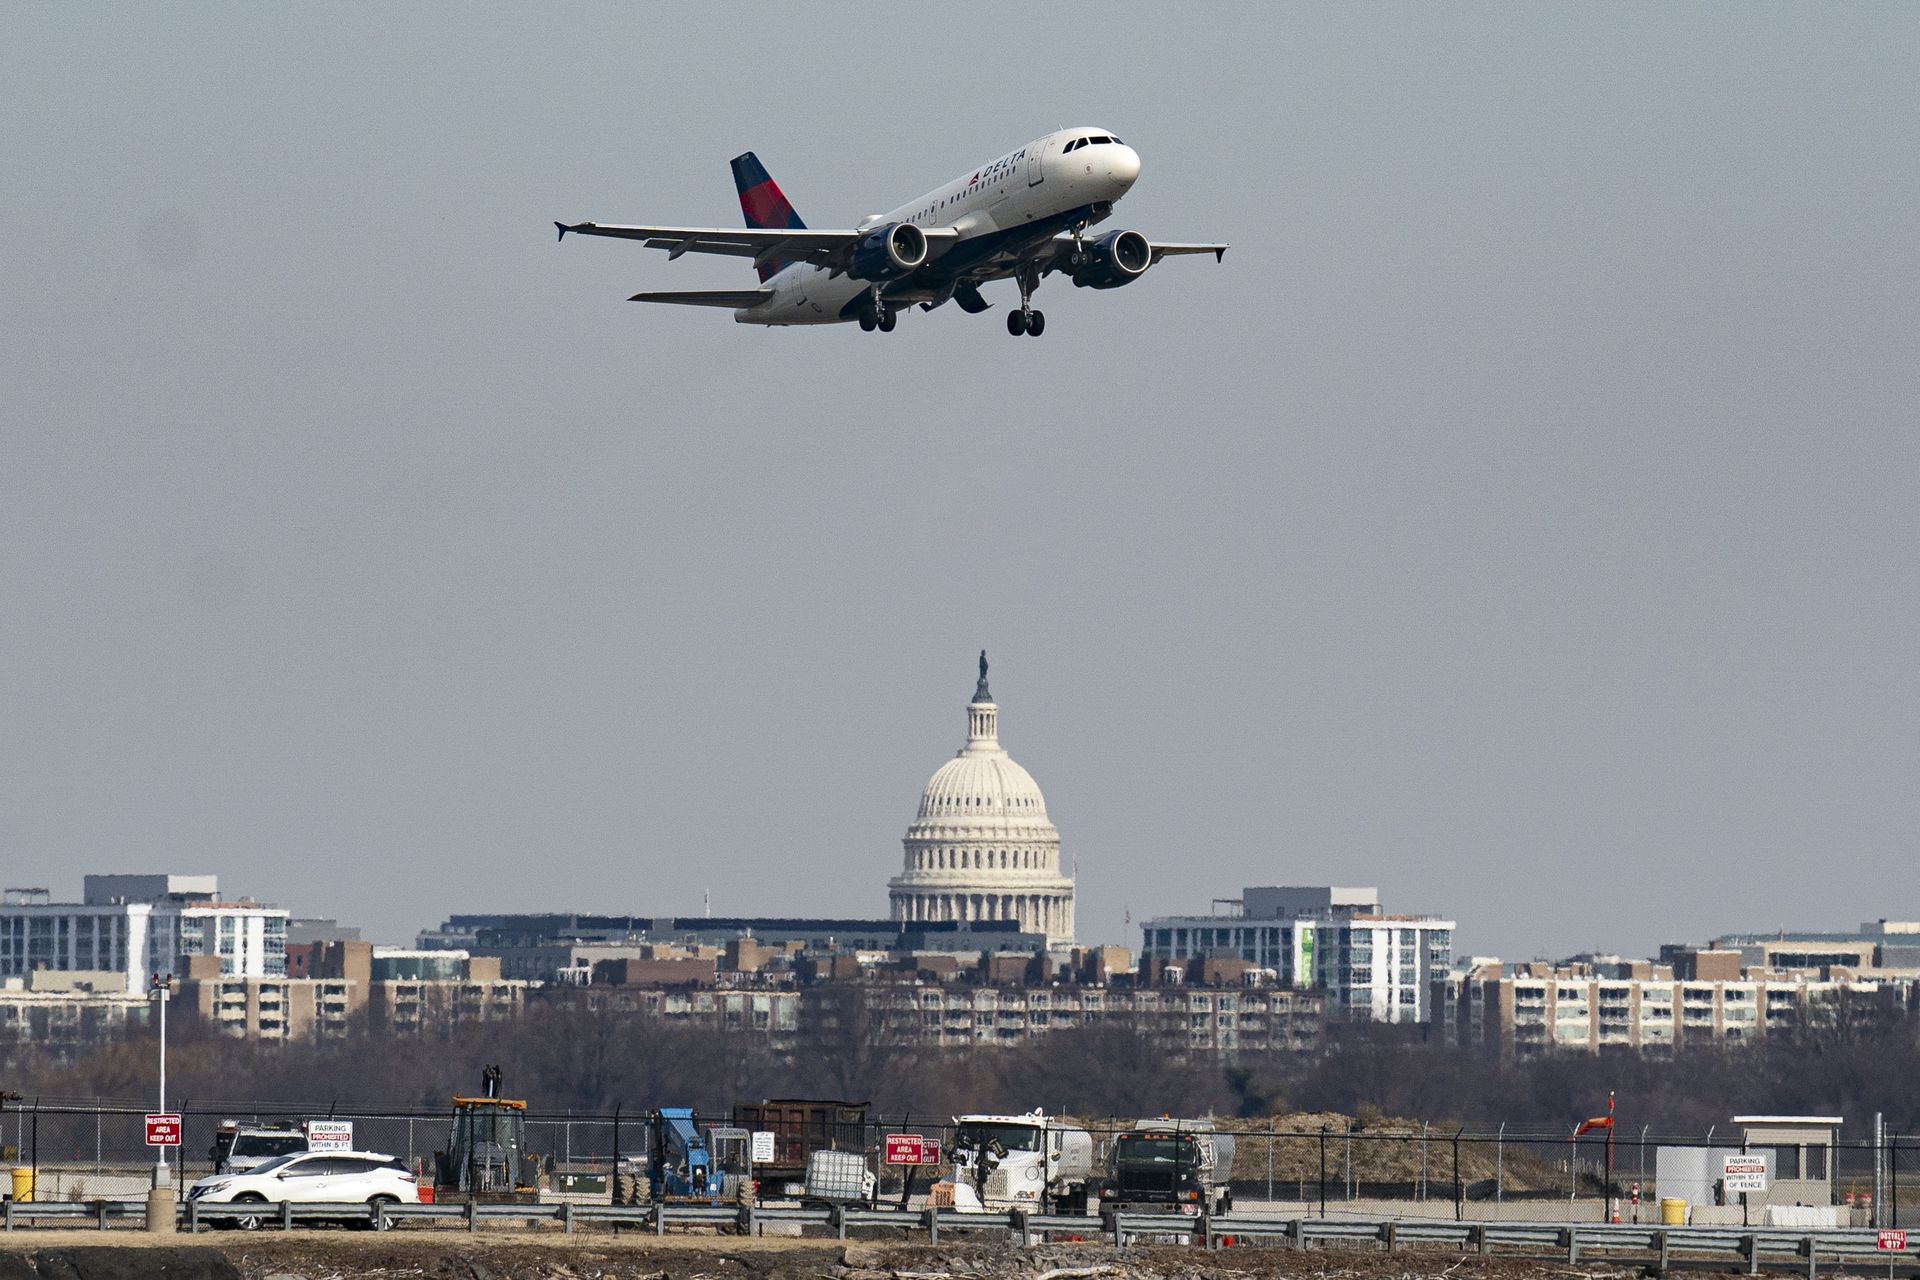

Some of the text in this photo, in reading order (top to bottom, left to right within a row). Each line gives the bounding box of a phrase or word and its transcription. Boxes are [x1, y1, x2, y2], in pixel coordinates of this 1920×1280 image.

[983, 148, 1026, 178] DELTA
[165, 1134, 176, 1142] OUT
[888, 1137, 922, 1145] RESTRICTED
